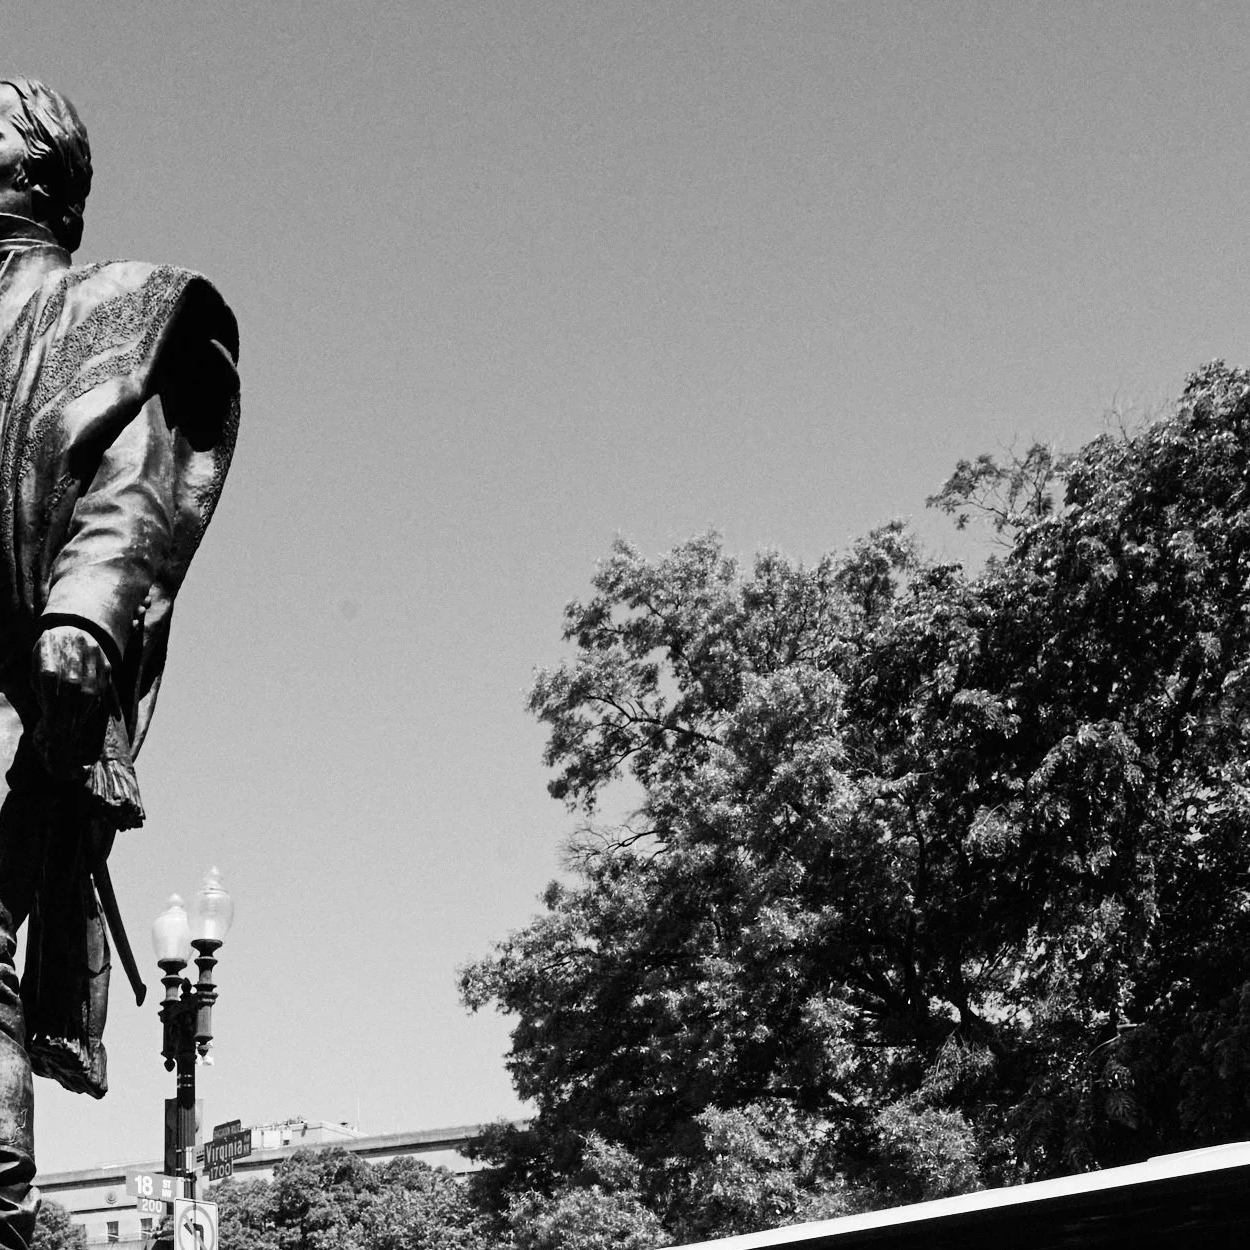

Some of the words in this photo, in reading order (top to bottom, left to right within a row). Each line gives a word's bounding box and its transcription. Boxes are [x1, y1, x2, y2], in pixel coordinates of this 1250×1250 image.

[205, 1137, 243, 1164] Virginia
[210, 1162, 231, 1180] 1700
[134, 1174, 153, 1196] 18
[162, 1179, 171, 1189] ST
[141, 1198, 162, 1213] 200
